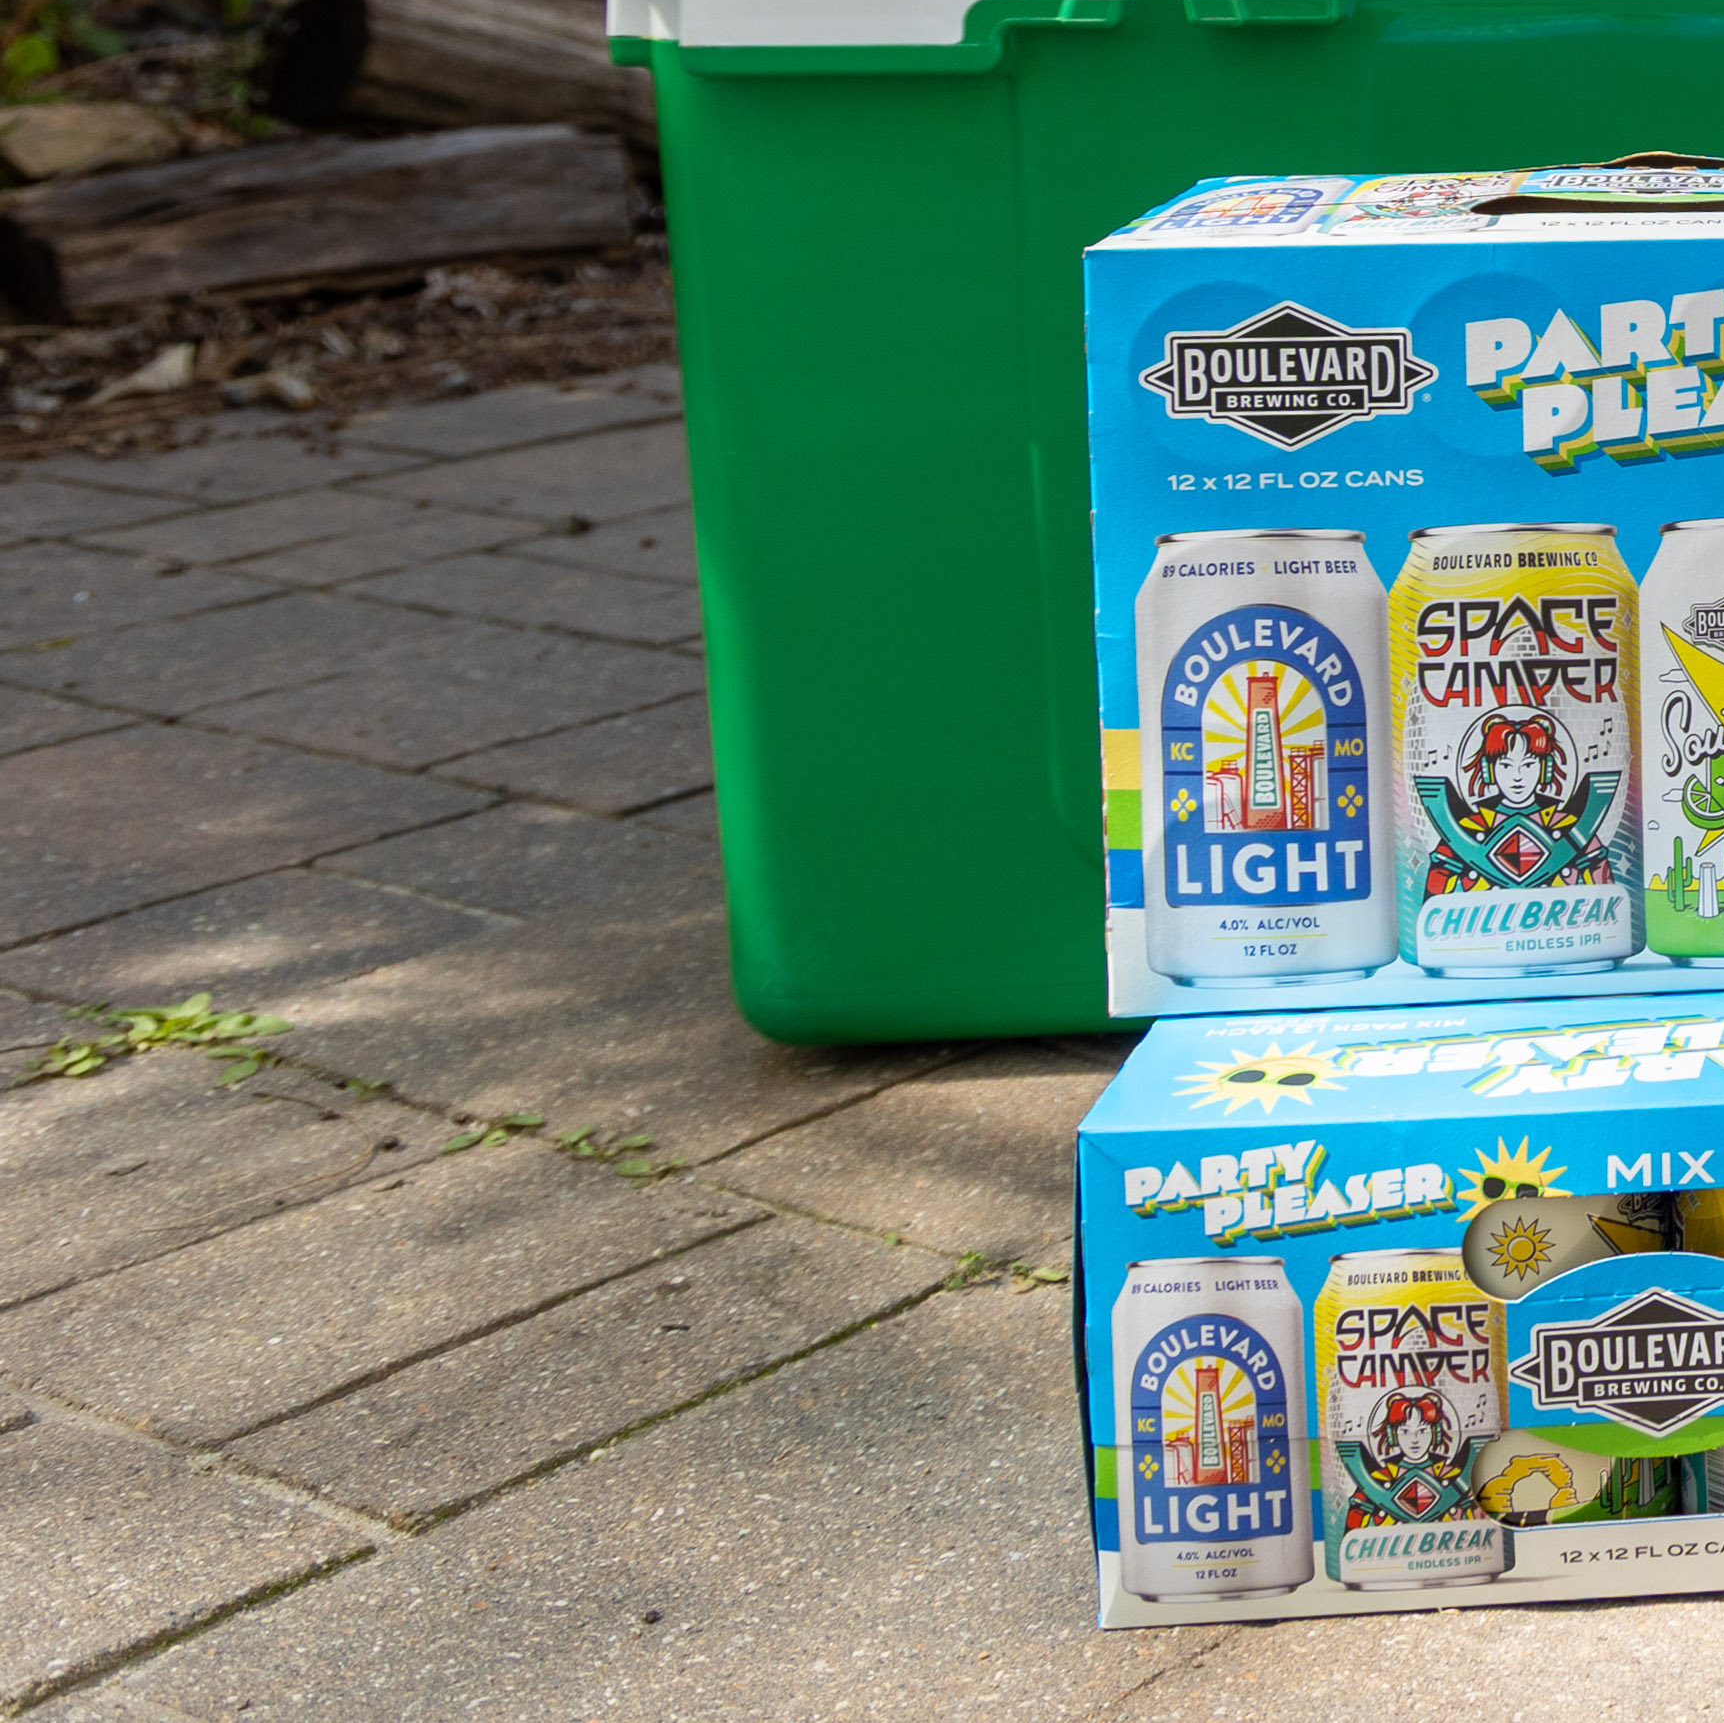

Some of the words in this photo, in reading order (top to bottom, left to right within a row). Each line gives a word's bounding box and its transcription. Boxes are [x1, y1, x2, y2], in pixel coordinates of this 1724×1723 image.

[1162, 213, 1300, 228] LIGHT
[1183, 345, 1396, 402] BOULEVARD
[1226, 394, 1319, 408] BREWING
[1326, 393, 1356, 406] CO.
[1167, 474, 1196, 491] 12
[1202, 478, 1217, 490] x
[1224, 474, 1252, 490] 12
[1259, 472, 1294, 489] FL
[1299, 472, 1338, 488] OZ
[1345, 469, 1424, 488] CANS
[1162, 564, 1175, 578] 89
[1178, 561, 1255, 578] CALORIES
[1273, 560, 1320, 576] LIGHT
[1324, 560, 1357, 575] BEER
[1433, 554, 1513, 571] BOULEVARD
[1517, 552, 1582, 568] BREWING
[1417, 593, 1619, 659] SPACE
[1174, 618, 1353, 708] BOULEVARD
[1417, 658, 1618, 707] CAMPER
[1170, 741, 1194, 761] KC
[1255, 712, 1277, 806] BOULEVARD
[1334, 738, 1364, 758] MO
[1177, 839, 1363, 896] LIGHT
[1219, 919, 1249, 932] 4.0%
[1257, 916, 1320, 931] ALC/VOL
[1423, 895, 1622, 941] CHILLBREAK
[1243, 944, 1256, 957] 12
[1259, 944, 1275, 957] FL
[1277, 943, 1297, 957] OZ
[1505, 935, 1574, 953] ENDLESS
[1578, 933, 1601, 948] IPA
[1124, 1139, 1320, 1209] PARTY
[1607, 1148, 1715, 1190] MIX
[1204, 1163, 1450, 1238] PLEASER
[1143, 1281, 1201, 1294] CALORIES
[1215, 1280, 1252, 1292] LIGHT
[1254, 1279, 1279, 1291] BEER
[1347, 1270, 1408, 1286] BOULEVARD
[1412, 1268, 1462, 1284] BREWING
[1335, 1301, 1490, 1352] SPACE
[1140, 1324, 1277, 1393] BOULEVARD
[1335, 1349, 1490, 1389] CAMPER
[1594, 1377, 1687, 1398] BREWING
[1694, 1376, 1724, 1393] CO.
[1137, 1417, 1156, 1433] KC
[1202, 1394, 1216, 1468] BOULEVARD
[1262, 1414, 1285, 1429] MO
[1142, 1490, 1287, 1536] LIGHT
[1176, 1550, 1200, 1561] 4.0%
[1205, 1548, 1255, 1560] ALC/VOL
[1344, 1528, 1498, 1563] CHILLBREAK
[1560, 1550, 1582, 1564] 12
[1589, 1551, 1600, 1562] x
[1605, 1547, 1629, 1561] 12
[1636, 1545, 1663, 1559] FL
[1666, 1542, 1699, 1557] OZ
[1195, 1569, 1206, 1580] 12
[1208, 1569, 1219, 1580] FL
[1221, 1568, 1238, 1579] OZ
[1407, 1557, 1462, 1571] ENDLESS
[1463, 1555, 1482, 1566] IPA
